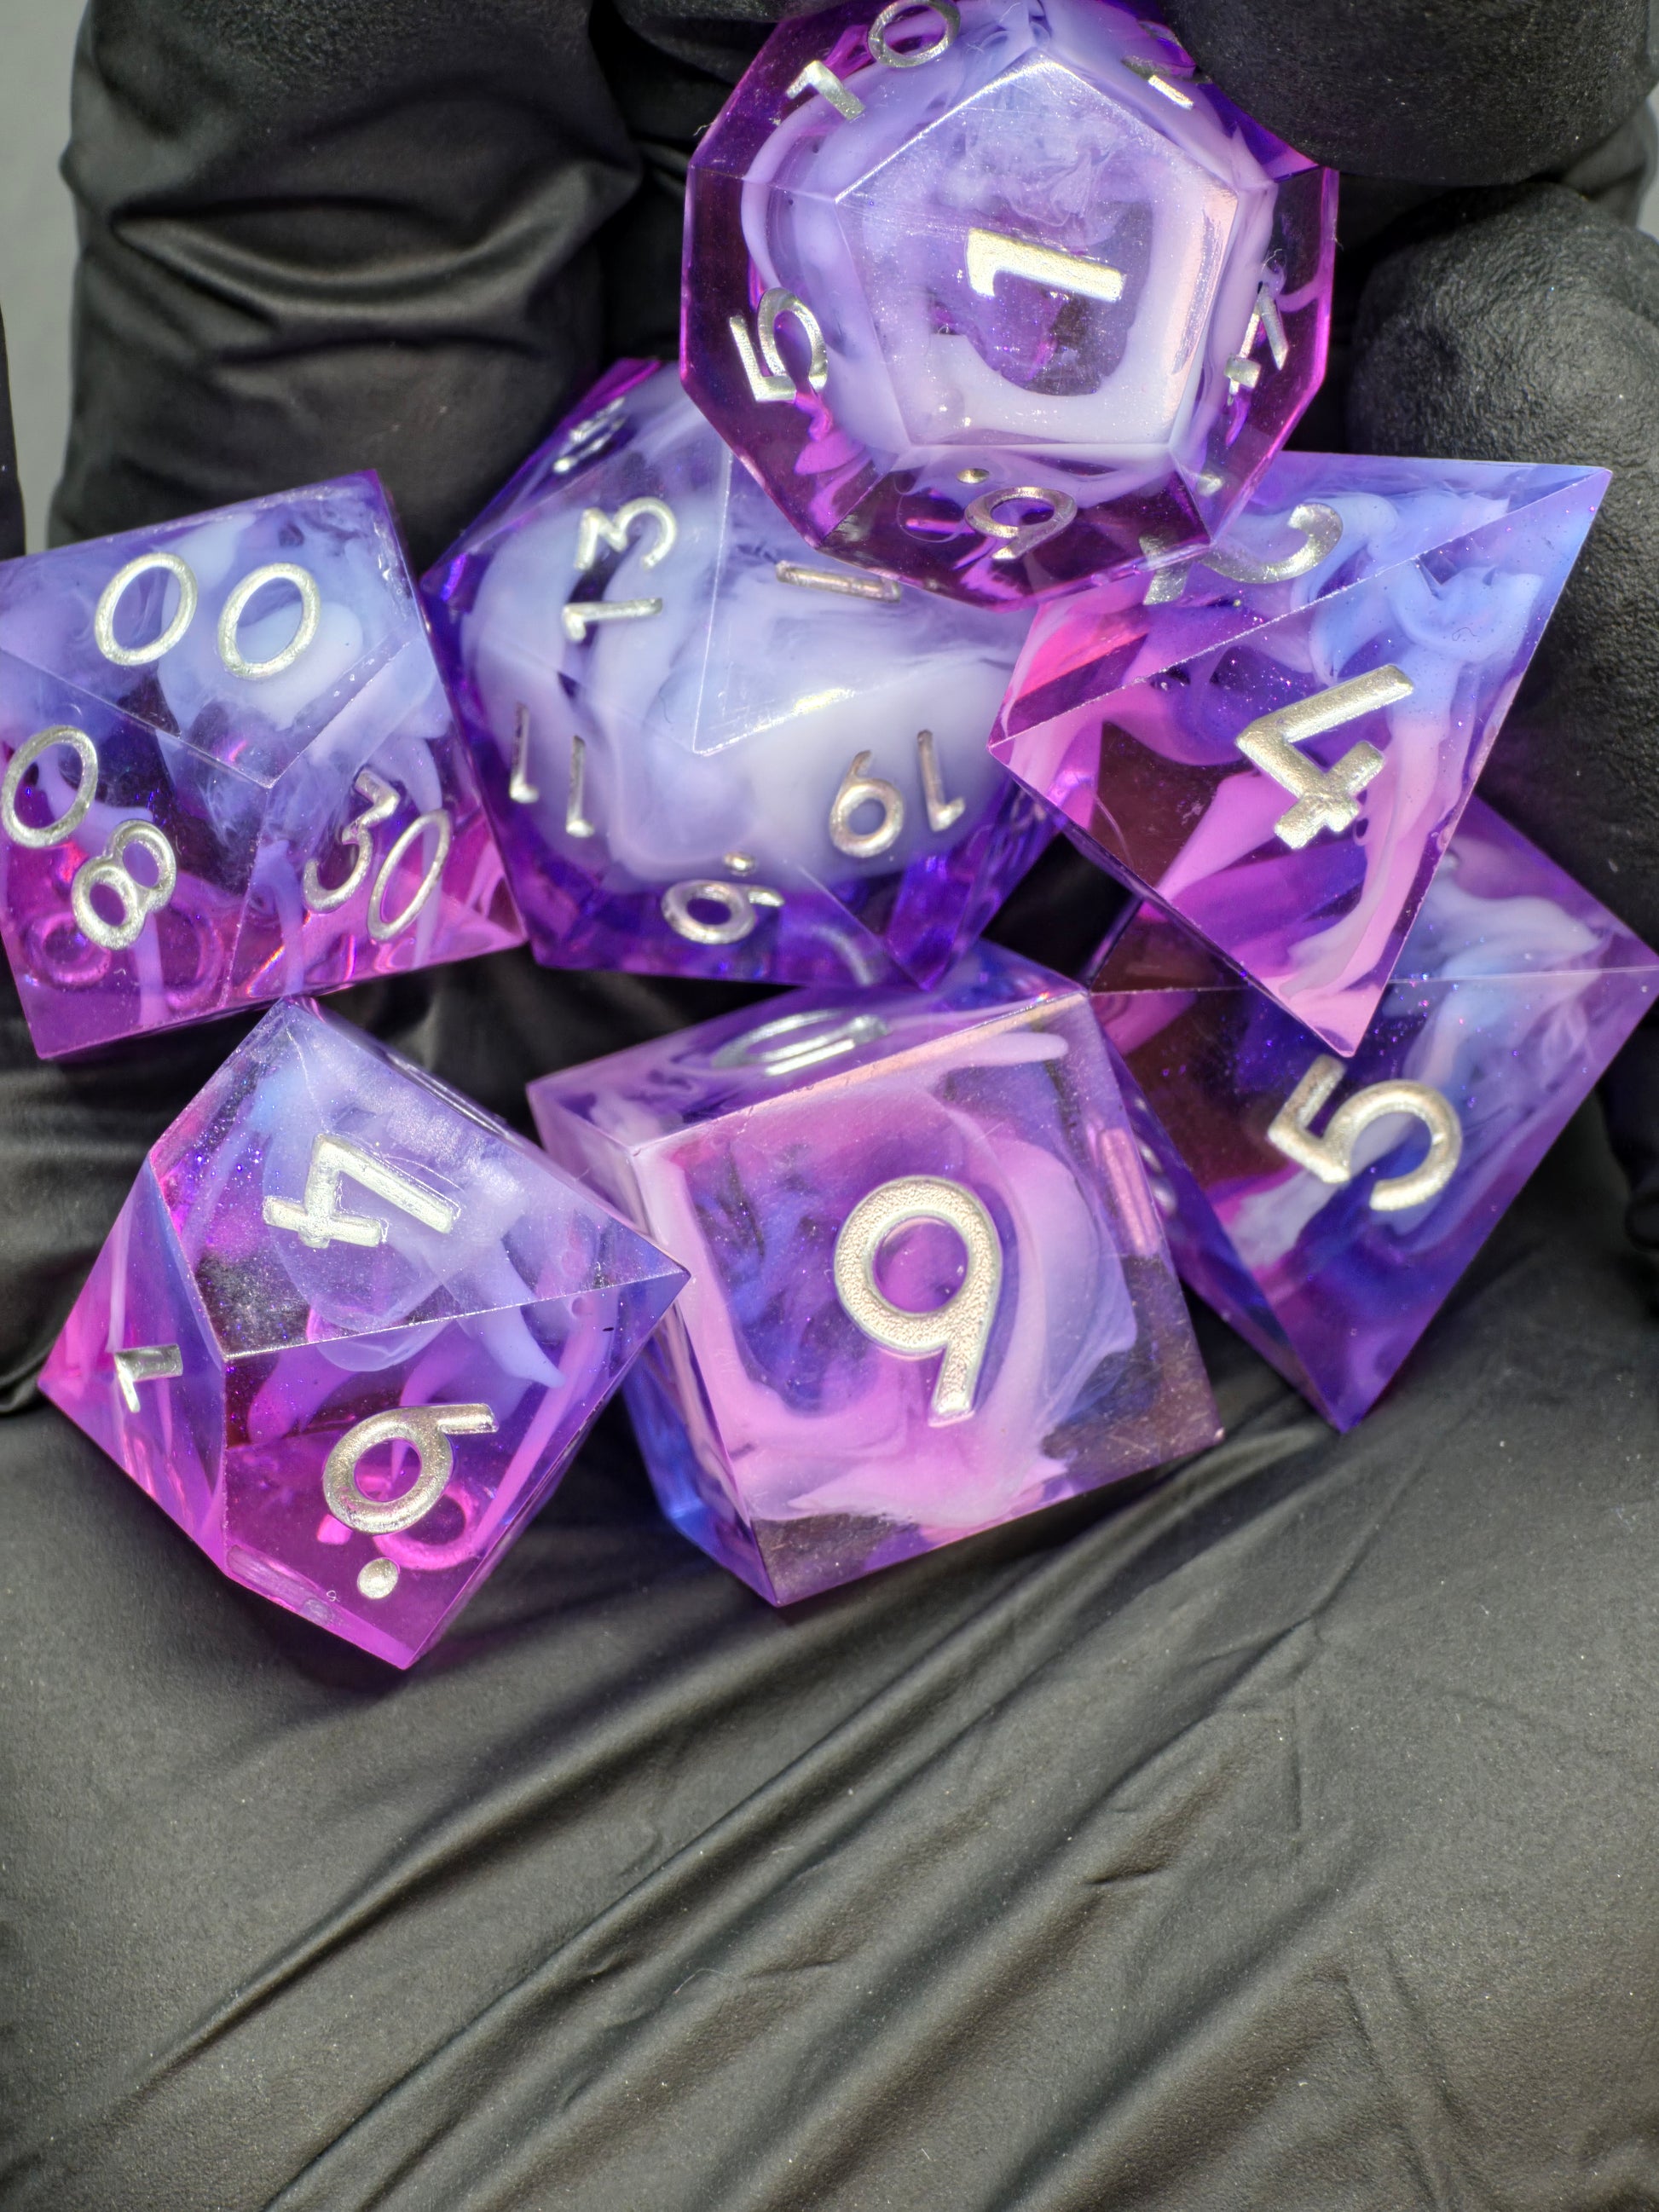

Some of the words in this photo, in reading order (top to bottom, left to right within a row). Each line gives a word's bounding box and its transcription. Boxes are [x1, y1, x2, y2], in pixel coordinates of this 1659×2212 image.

[966, 228, 1126, 302] 1
[95, 552, 321, 681] 00
[1235, 663, 1414, 850] 4
[303, 768, 452, 940] 30
[263, 1133, 462, 1248] 4
[1267, 1054, 1463, 1212] 5
